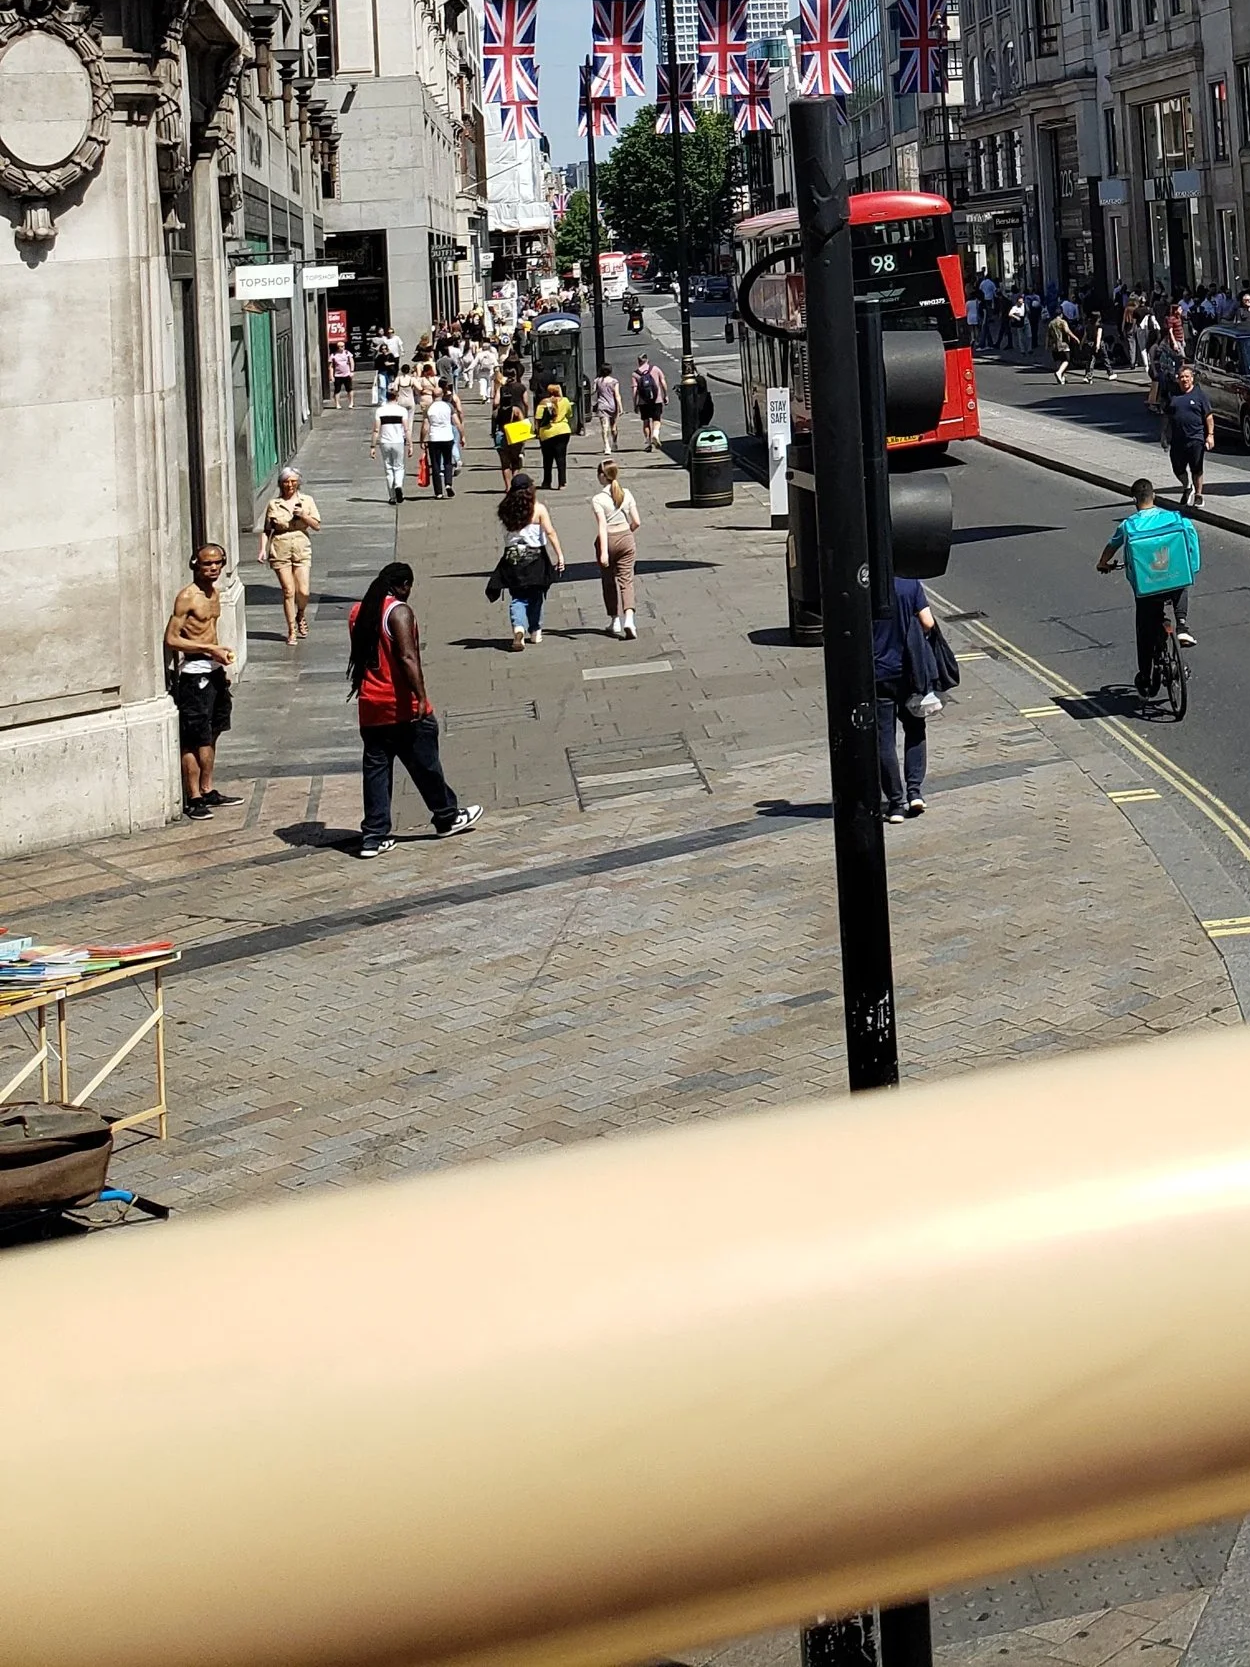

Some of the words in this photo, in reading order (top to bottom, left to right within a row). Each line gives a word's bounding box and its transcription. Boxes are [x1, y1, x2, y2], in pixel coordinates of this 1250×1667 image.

[995, 216, 1020, 225] Bershka
[870, 254, 896, 274] 98
[239, 276, 291, 288] TOPSHOP
[305, 273, 337, 282] TOPSHOP
[769, 400, 787, 412] STAY
[770, 412, 788, 424] SAFE
